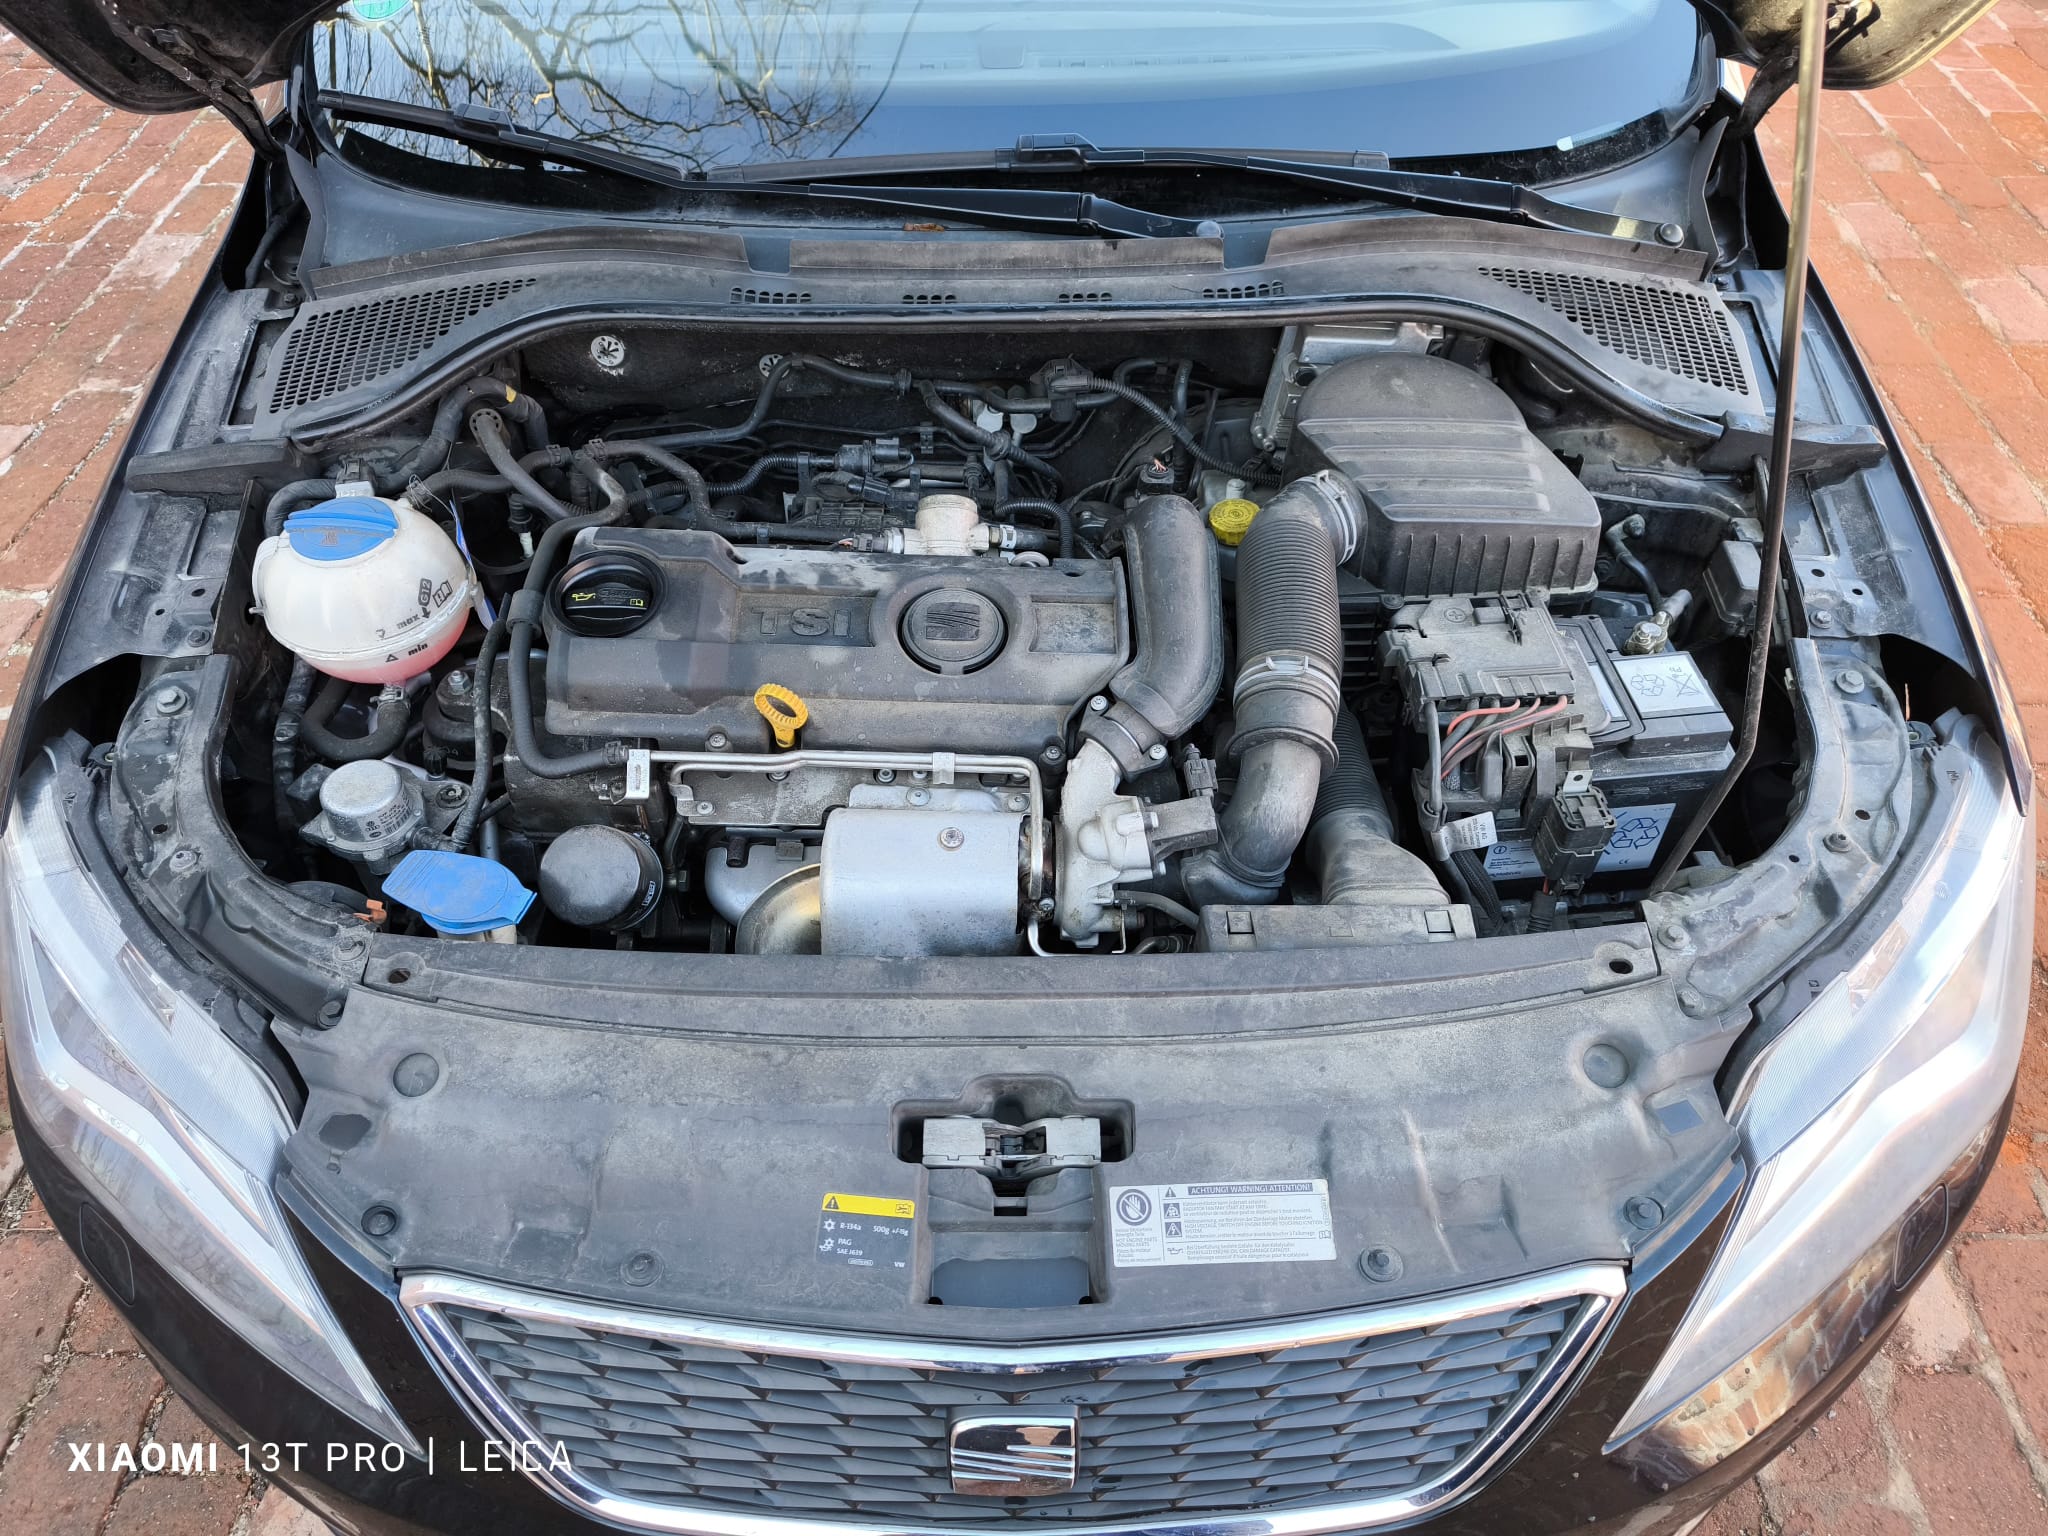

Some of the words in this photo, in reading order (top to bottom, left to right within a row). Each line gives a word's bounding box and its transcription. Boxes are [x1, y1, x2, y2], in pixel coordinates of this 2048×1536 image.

[420, 580, 430, 602] G12
[396, 614, 420, 629] max
[751, 607, 852, 637] TSI
[408, 642, 428, 656] min
[1190, 1186, 1228, 1194] ACHTUNG!
[1230, 1184, 1268, 1192] WARNING!
[1268, 1183, 1311, 1191] ATTENTION!
[838, 1238, 852, 1246] PAG
